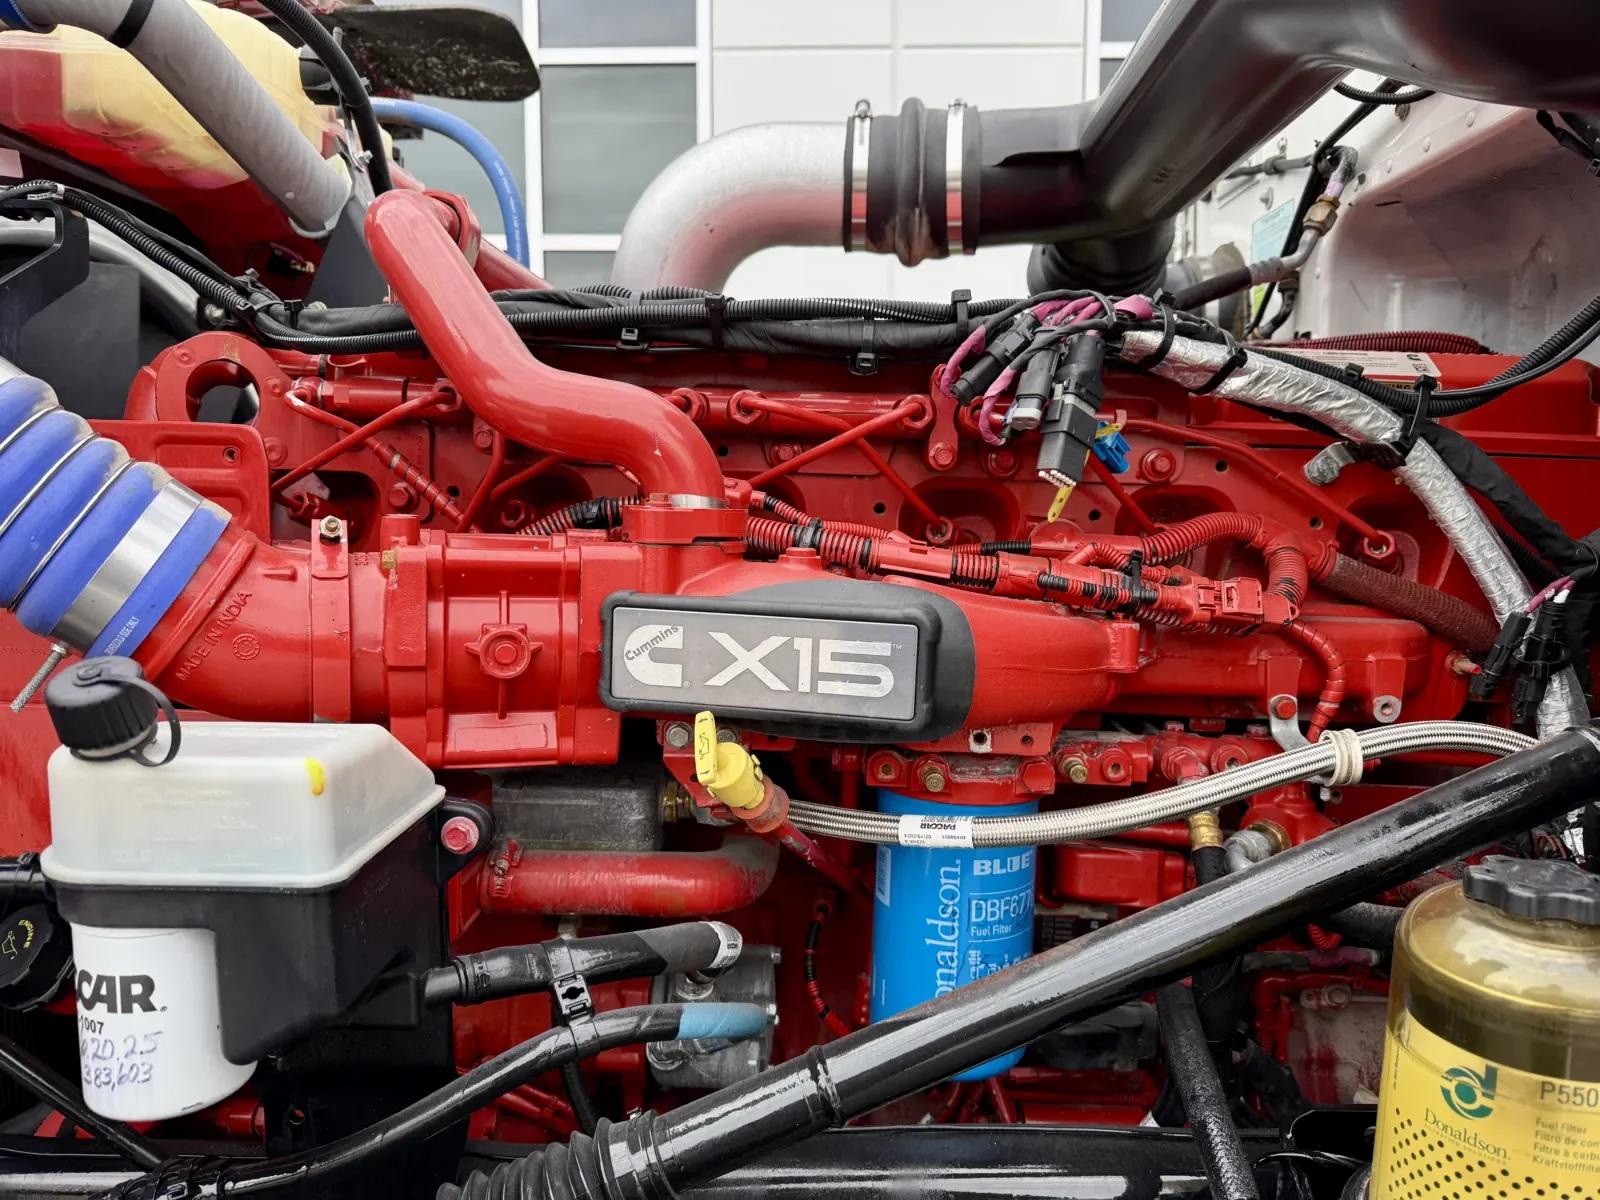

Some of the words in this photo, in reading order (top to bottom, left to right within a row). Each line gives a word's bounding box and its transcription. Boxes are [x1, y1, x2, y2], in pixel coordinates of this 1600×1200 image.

[176, 645, 210, 680] MADE
[205, 627, 224, 646] IN
[216, 592, 252, 629] INDIA
[624, 625, 680, 662] Cummins
[704, 631, 894, 698] X15
[919, 821, 956, 831] PACCAR
[973, 853, 1030, 876] BLUE
[970, 926, 991, 937] Fuel
[992, 924, 1012, 936] Filter
[1540, 1080, 1600, 1109] P550
[1536, 1117, 1558, 1131] Fuel
[1561, 1120, 1588, 1134] Filter
[1535, 1130, 1561, 1145] Filtro
[1565, 1135, 1578, 1147] de
[1533, 1143, 1561, 1156] Filtre
